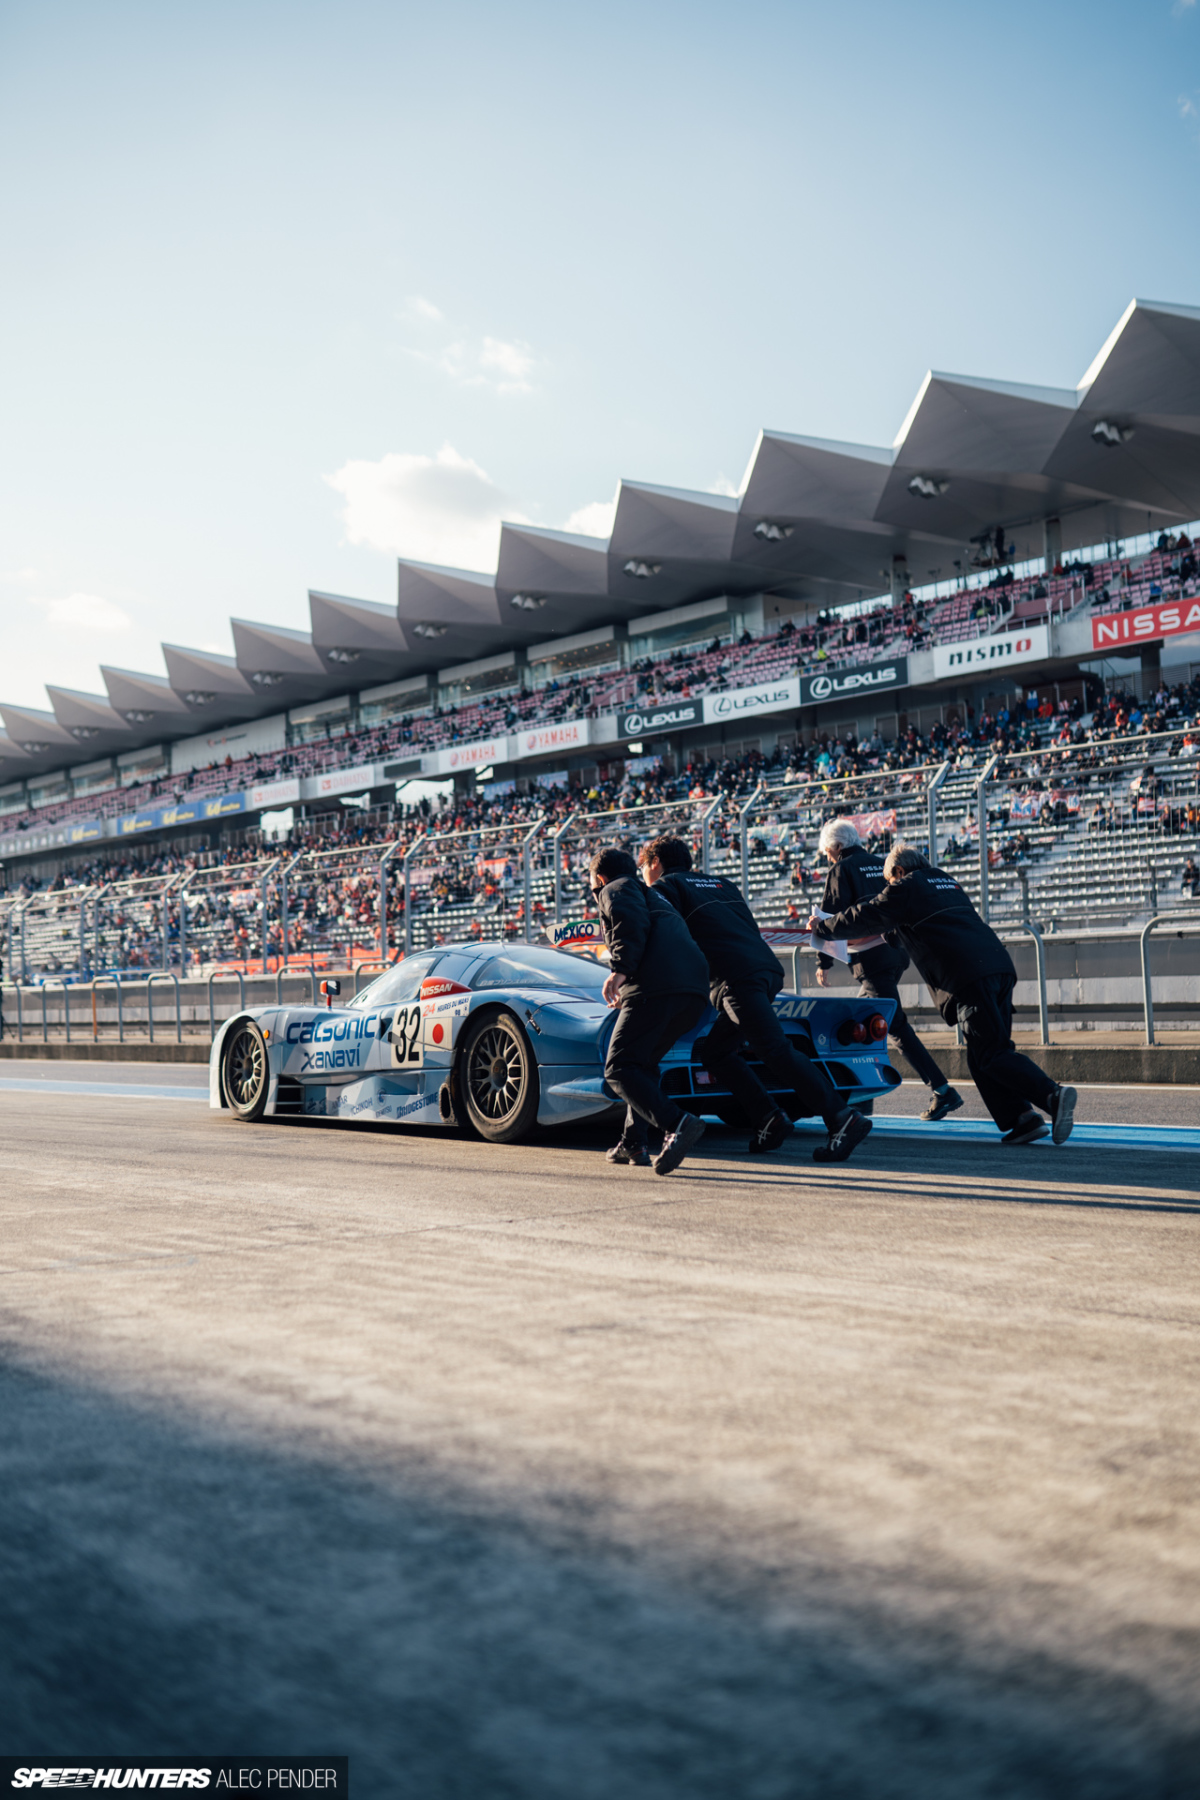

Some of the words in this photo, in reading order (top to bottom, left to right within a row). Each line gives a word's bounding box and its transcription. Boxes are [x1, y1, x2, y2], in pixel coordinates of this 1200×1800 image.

[1097, 604, 1200, 643] NISSA
[949, 638, 1032, 666] nismo
[831, 667, 897, 691] LEXUS
[733, 689, 789, 710] LEXUS
[643, 707, 695, 728] LEXUS
[538, 726, 579, 748] YAMAHA
[460, 745, 496, 765] YAMAHA
[333, 771, 369, 789] DAIHATSU
[554, 923, 594, 941] MEXICO
[421, 983, 453, 996] NISSAN
[422, 1003, 436, 1017] 24
[395, 1006, 421, 1063] 32
[396, 1092, 438, 1119] BRIDGESTONE
